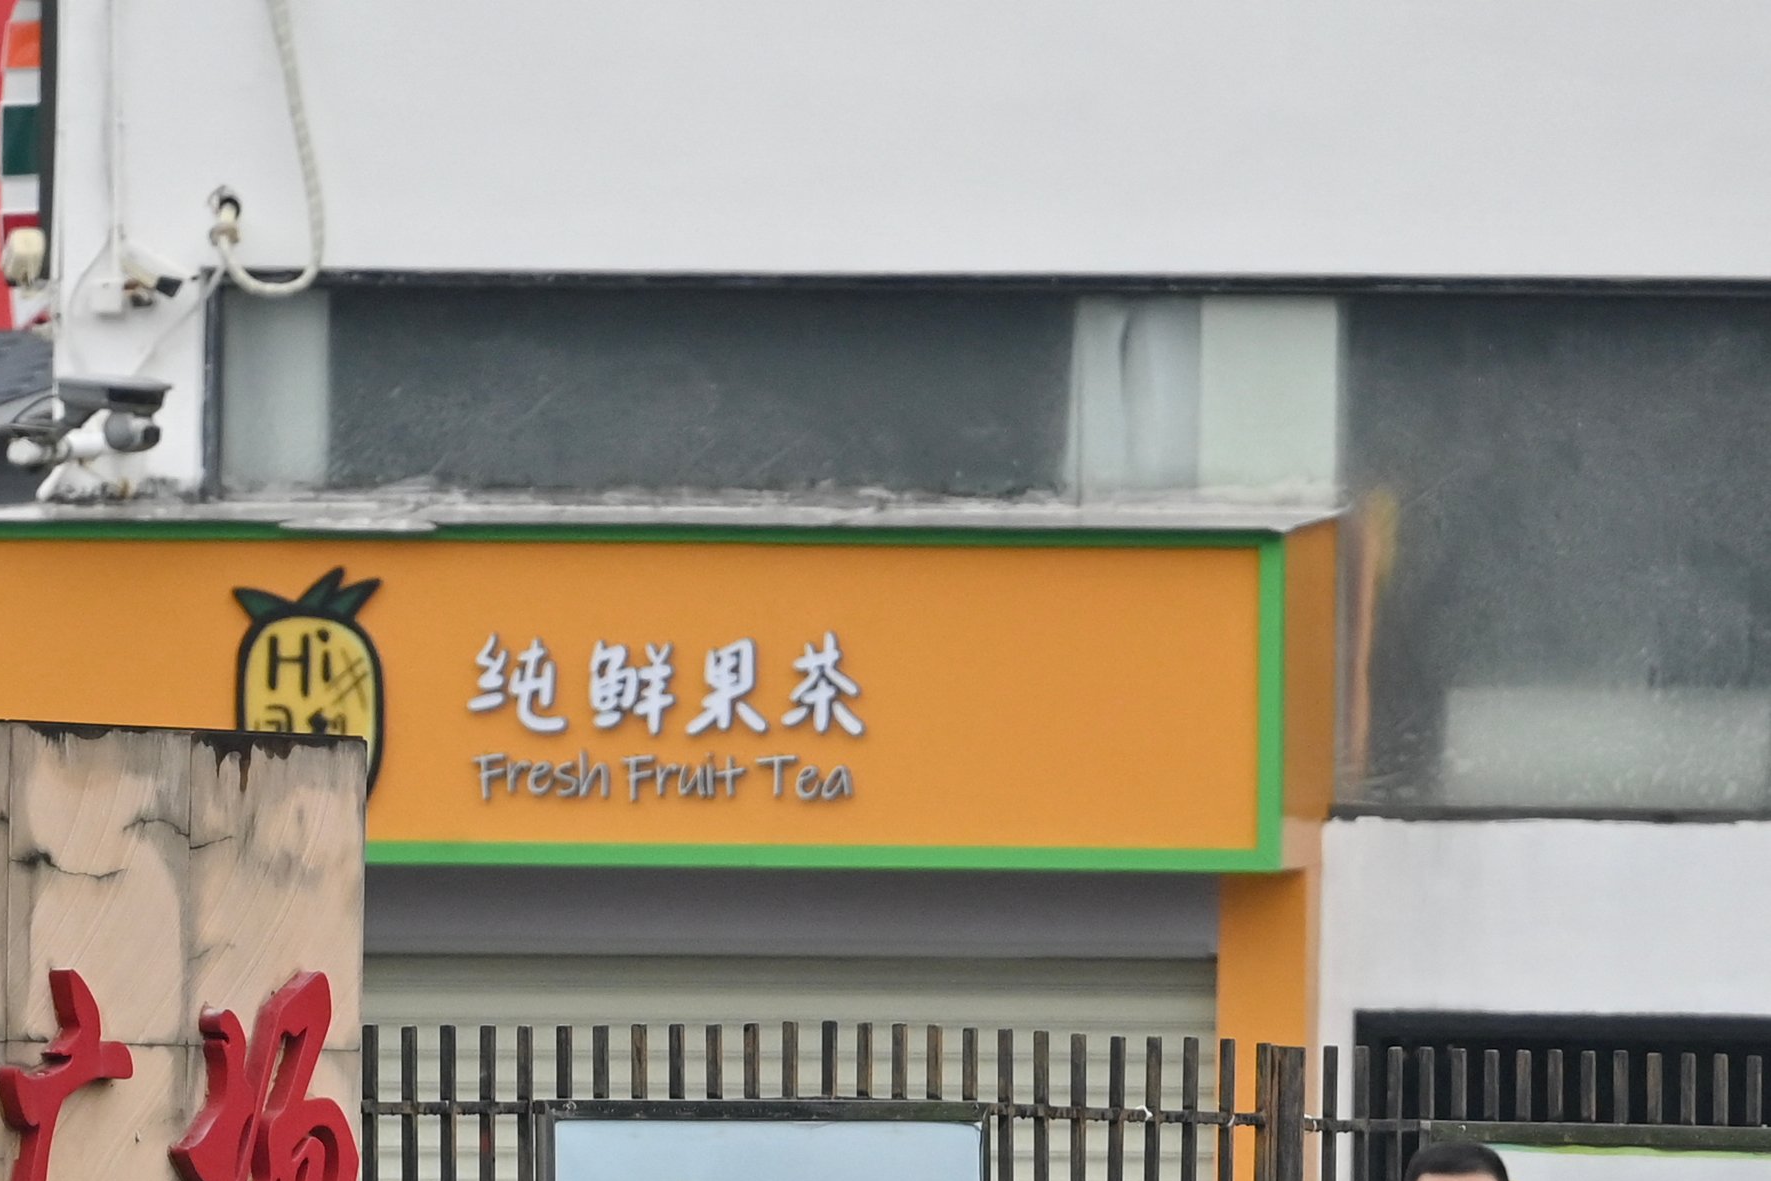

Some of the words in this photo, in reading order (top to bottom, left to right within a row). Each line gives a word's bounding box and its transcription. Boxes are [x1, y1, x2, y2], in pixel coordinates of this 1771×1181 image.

[266, 627, 332, 698] Hi
[466, 631, 866, 736] 纯鲜果茶
[473, 748, 610, 801] Fresh
[621, 751, 746, 802] Fruit
[755, 753, 854, 801] Tea
